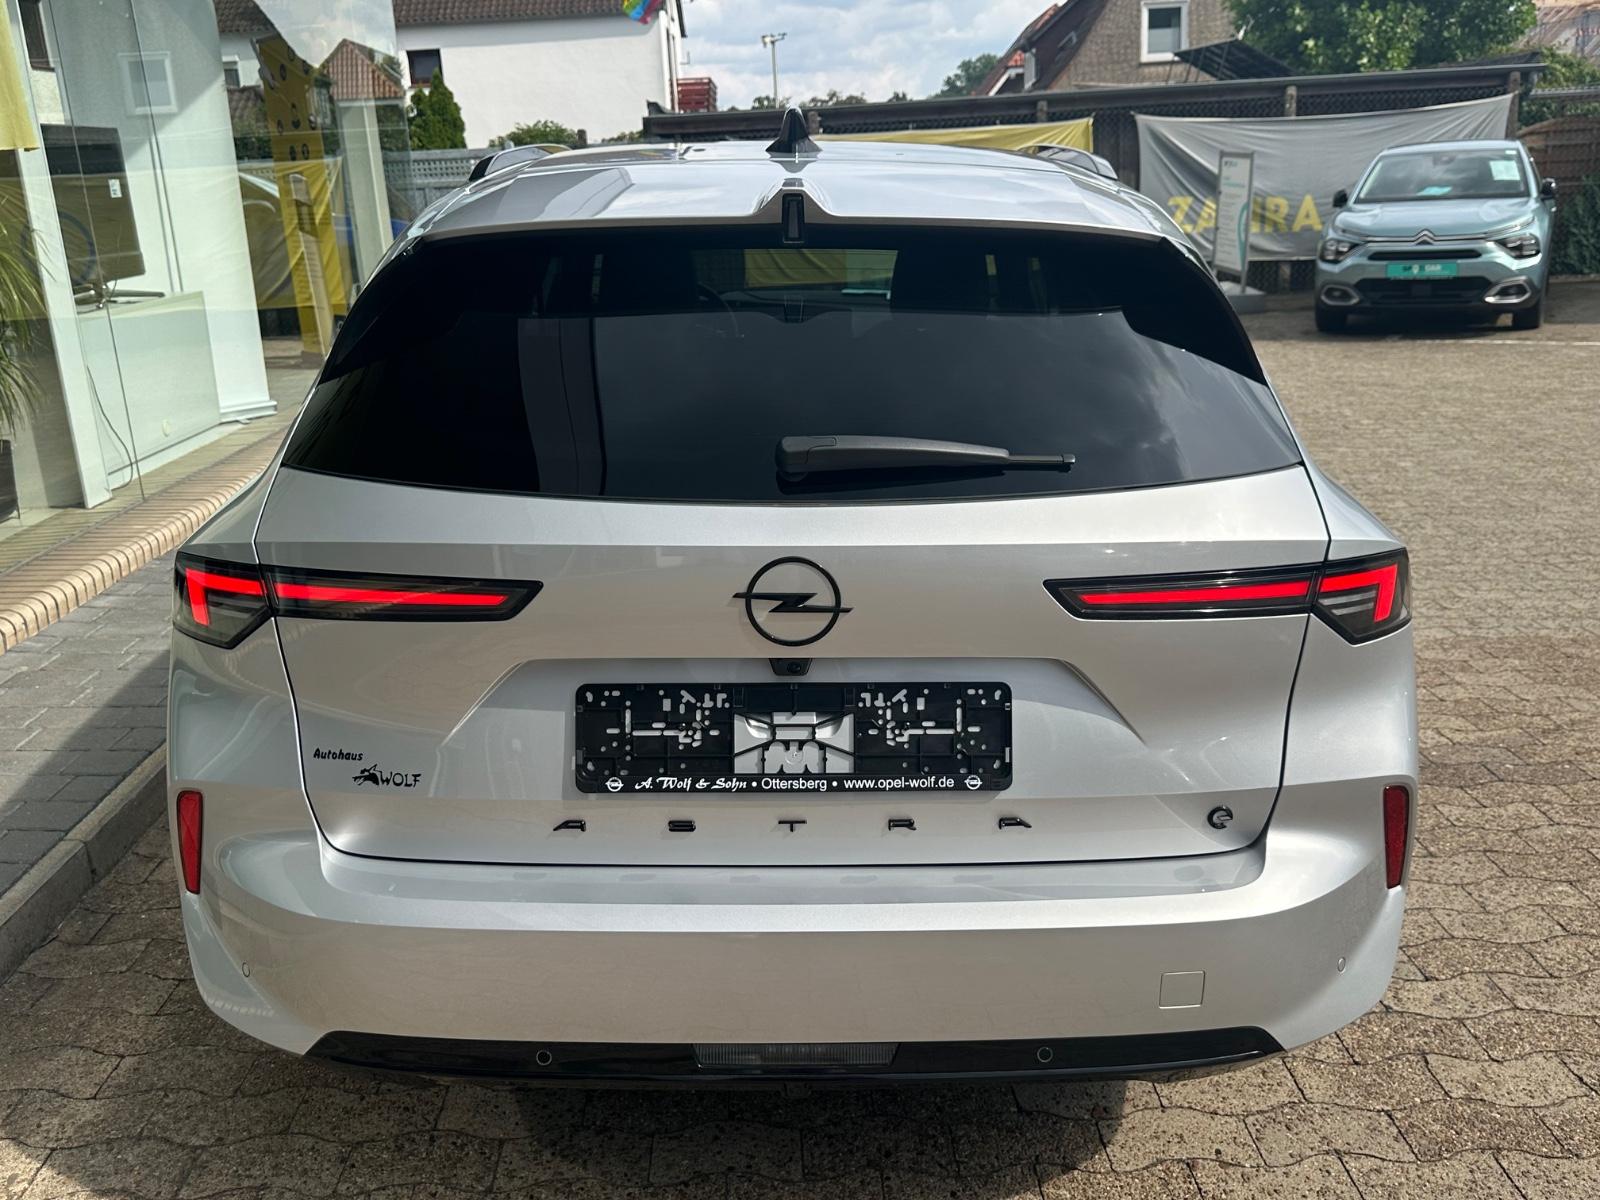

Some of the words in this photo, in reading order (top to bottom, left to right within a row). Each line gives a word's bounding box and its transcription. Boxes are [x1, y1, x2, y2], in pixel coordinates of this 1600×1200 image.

[1167, 194, 1324, 234] ZAIRA
[313, 747, 364, 761] Autohaus
[380, 770, 422, 788] WOLF
[634, 776, 653, 790] A.
[656, 776, 692, 792] Wolf
[695, 777, 711, 789] &
[711, 776, 747, 792] Sohn
[761, 777, 828, 791] Ottersberg
[843, 776, 955, 791] www.opel-wolf.de
[552, 816, 1032, 832] ASTRA
